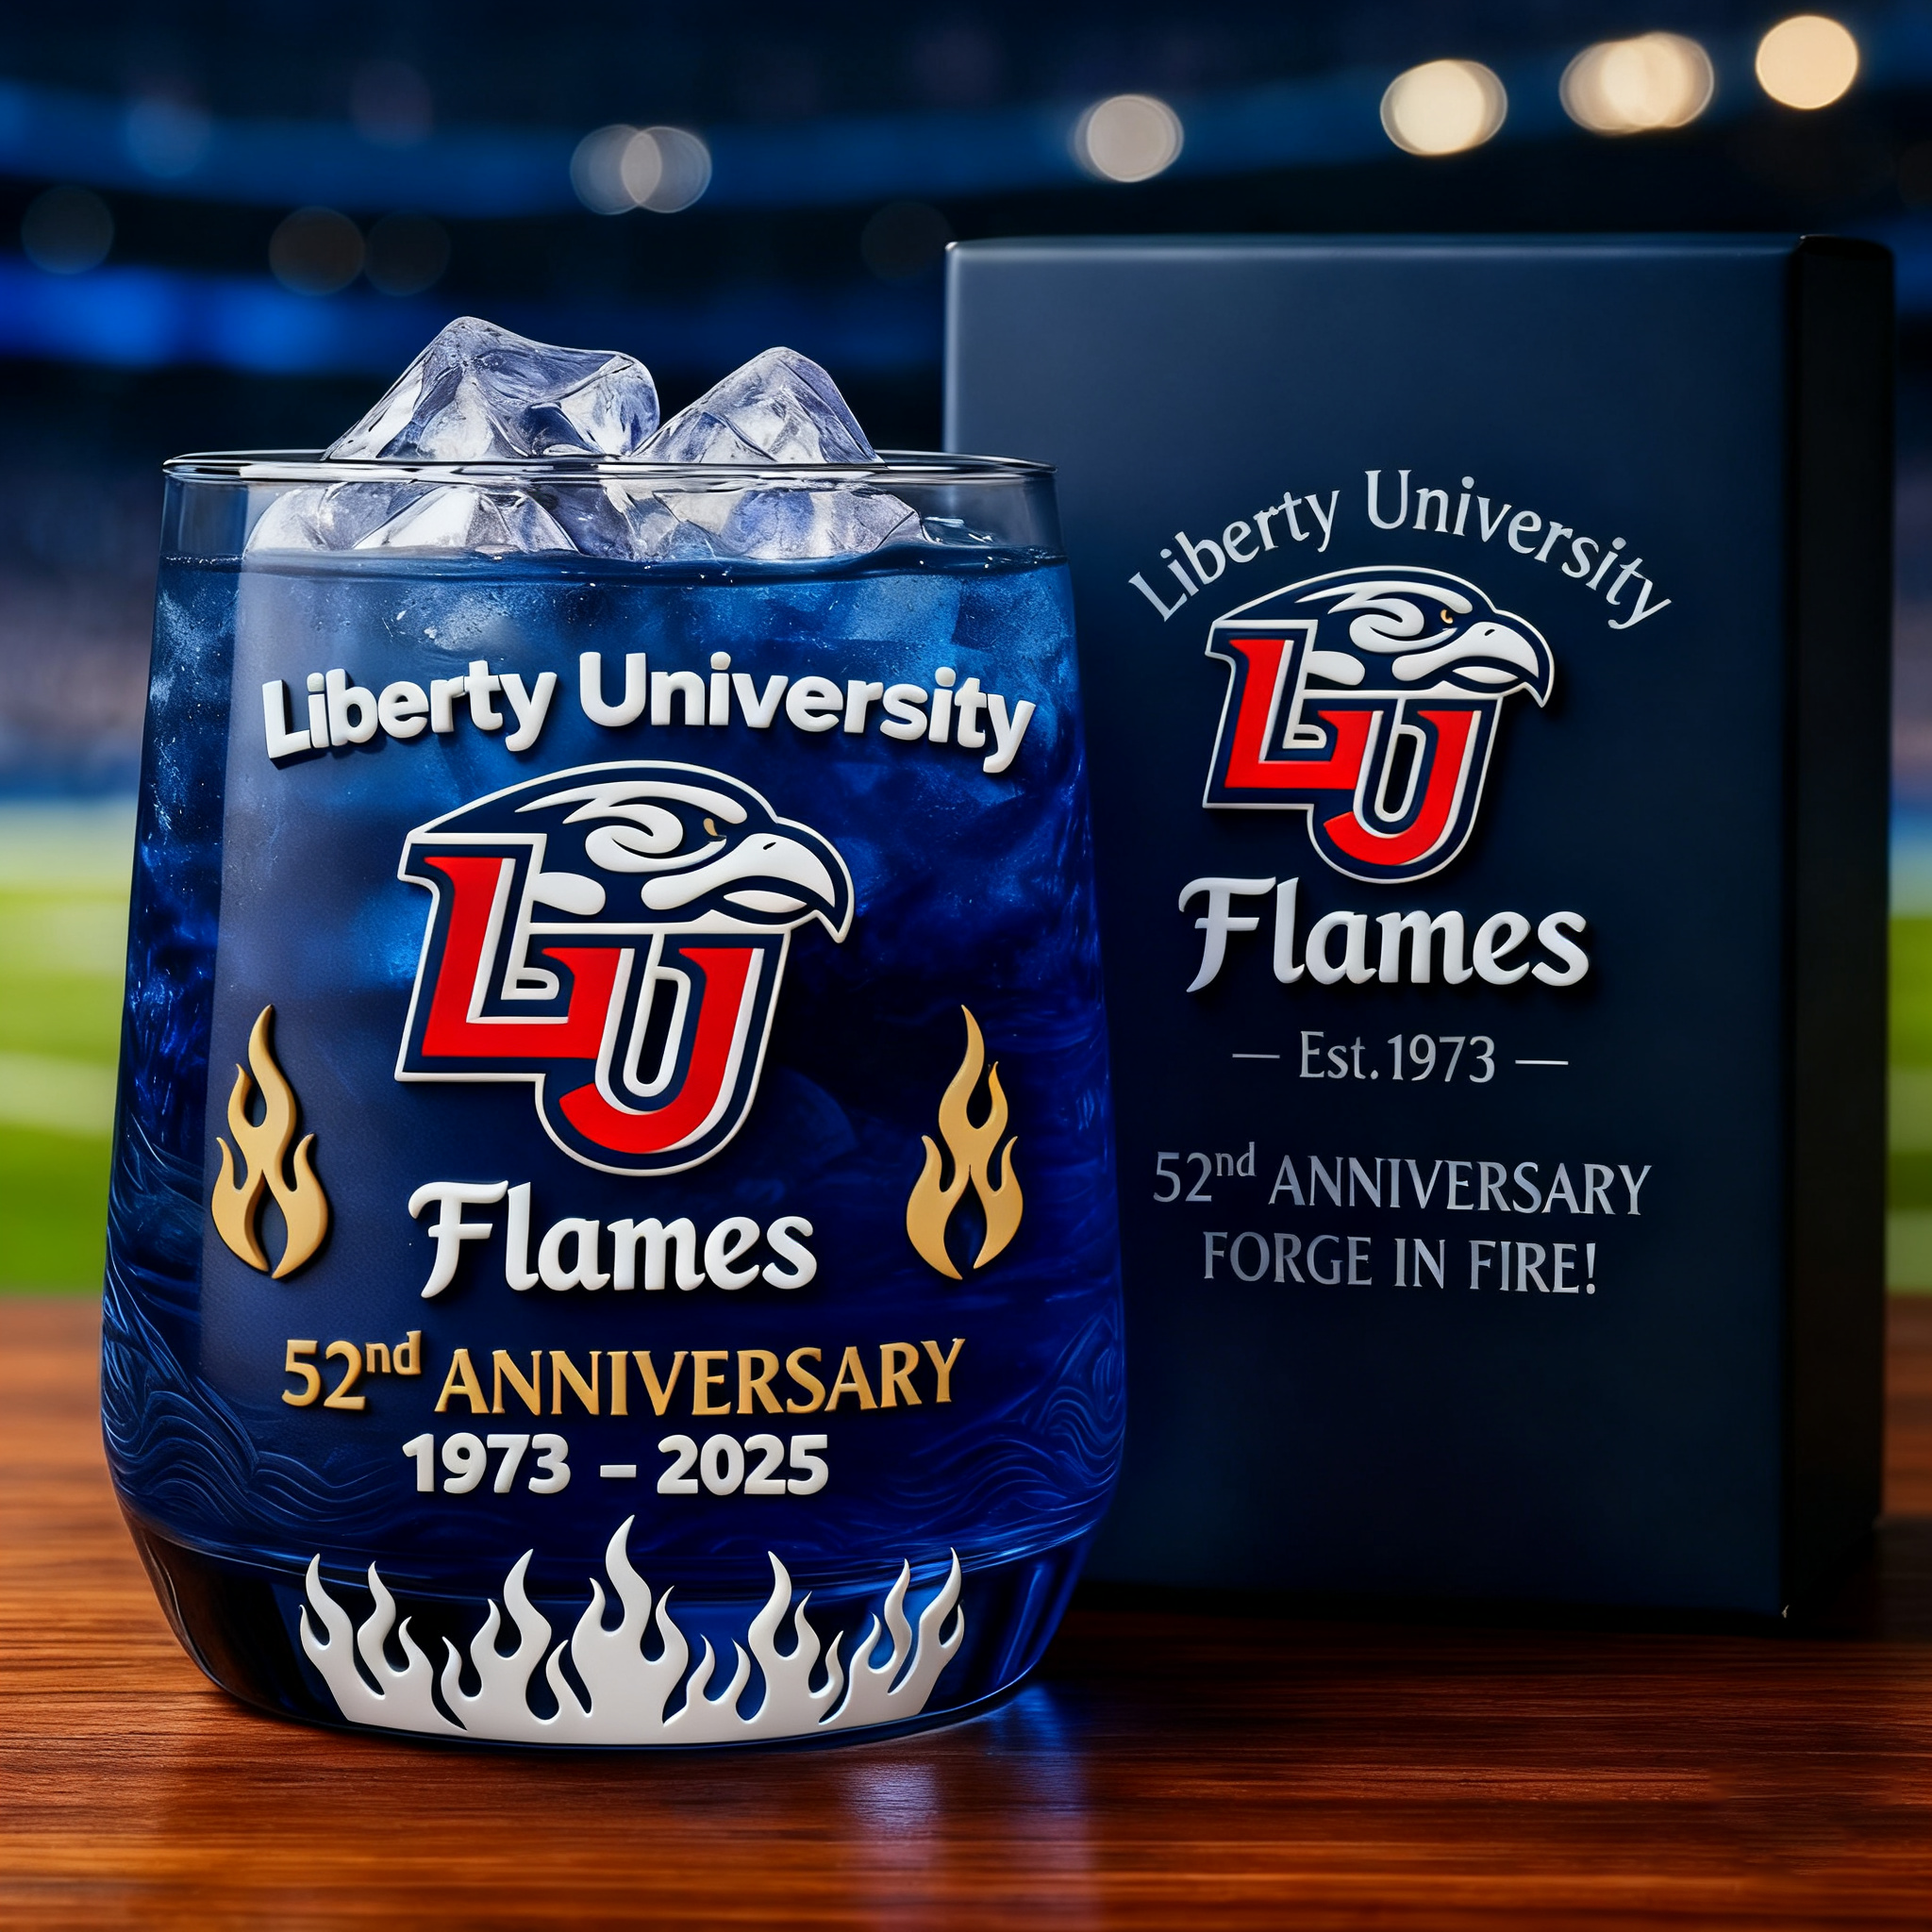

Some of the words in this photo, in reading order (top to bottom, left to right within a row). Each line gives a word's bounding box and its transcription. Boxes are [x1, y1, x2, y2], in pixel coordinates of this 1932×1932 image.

[1128, 491, 1340, 622] Liberty
[1365, 469, 1672, 629] University
[262, 660, 557, 759] Liberty
[579, 651, 1035, 774] University
[1178, 876, 1590, 992] Flames
[1153, 1141, 1256, 1203] 52nd
[1268, 1156, 1653, 1216] ANNIVERSARY
[408, 1180, 816, 1298] Flames
[1203, 1232, 1372, 1286] FORGE
[1394, 1239, 1445, 1290] IN
[1469, 1241, 1596, 1294] FIRE!
[282, 1331, 422, 1409] 52nd
[435, 1338, 965, 1416] ANNIVERSARY
[403, 1432, 571, 1494] 1973
[657, 1434, 828, 1495] 2025
